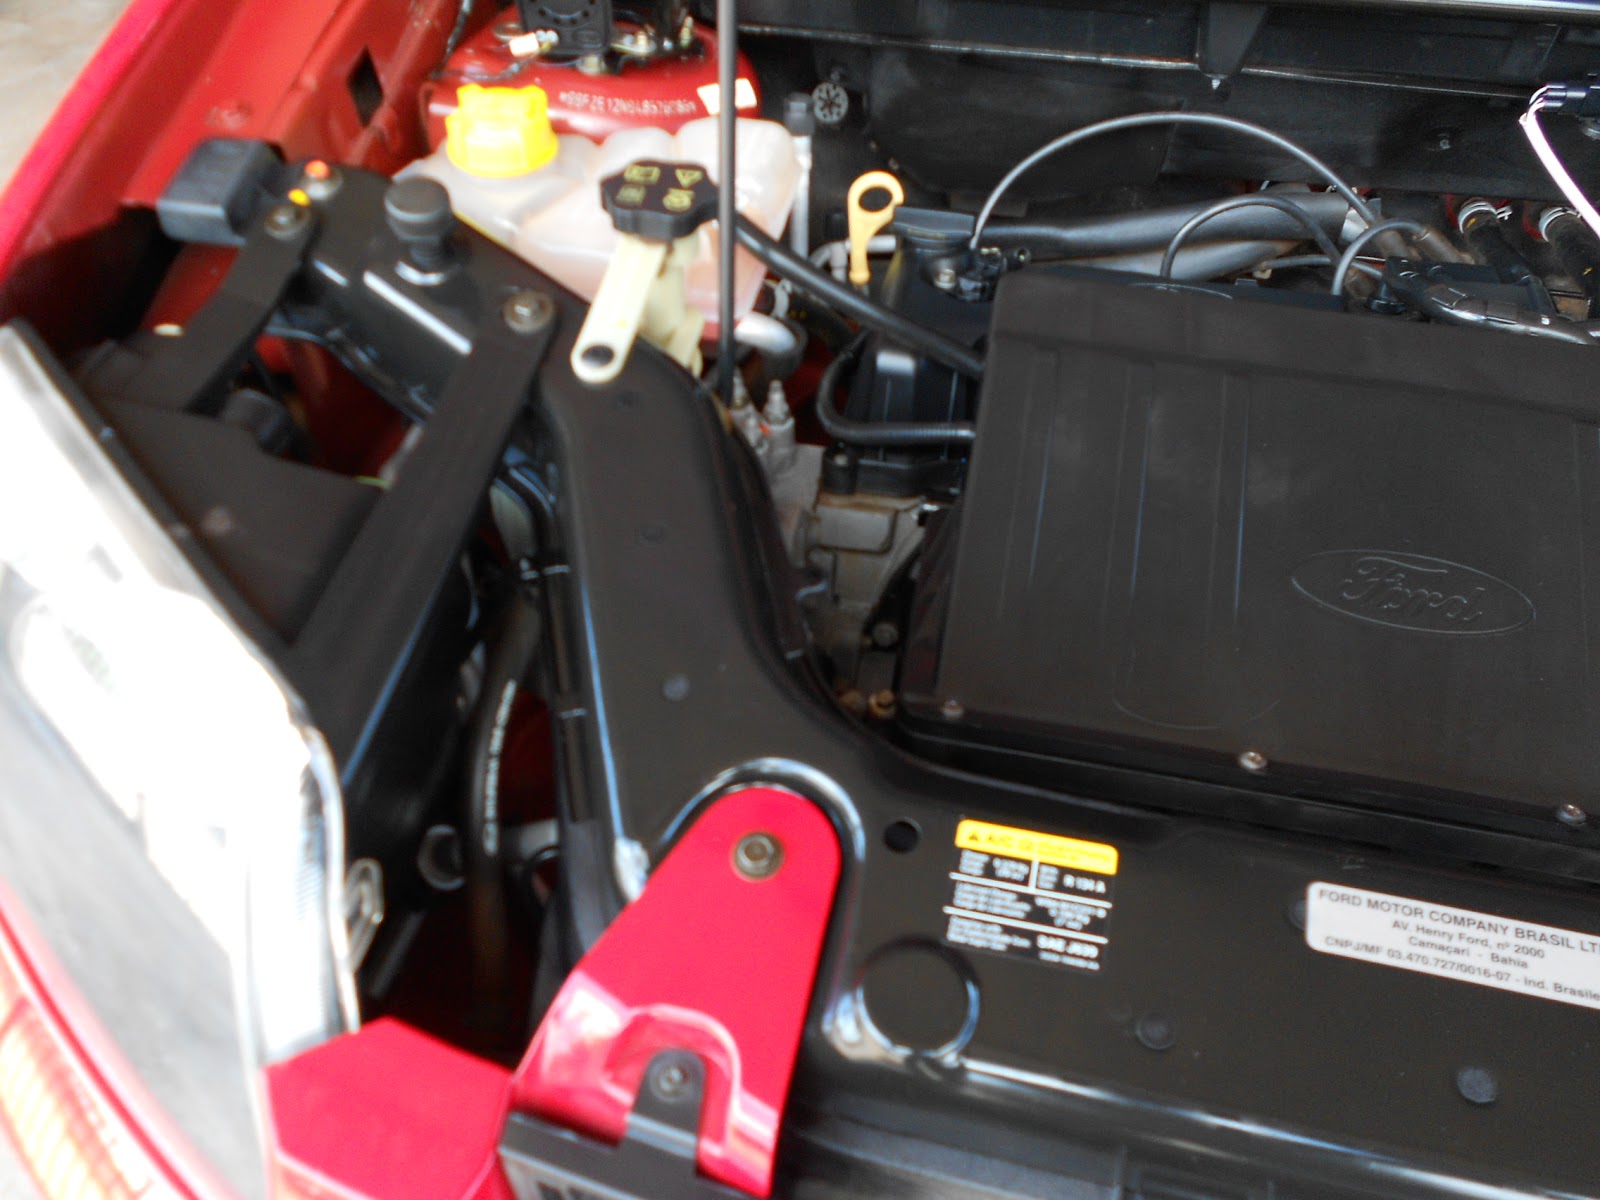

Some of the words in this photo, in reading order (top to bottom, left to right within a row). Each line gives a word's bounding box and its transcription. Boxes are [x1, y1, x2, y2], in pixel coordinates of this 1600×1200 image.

[1342, 556, 1486, 622] Ford
[1319, 889, 1362, 907] FORD
[1366, 898, 1424, 918] MOTOR
[1429, 910, 1509, 935] COMPANY
[1514, 927, 1574, 949] BRASIL
[1416, 925, 1453, 942] Henry
[1514, 943, 1545, 959] 2000
[1490, 952, 1528, 969] Bahia
